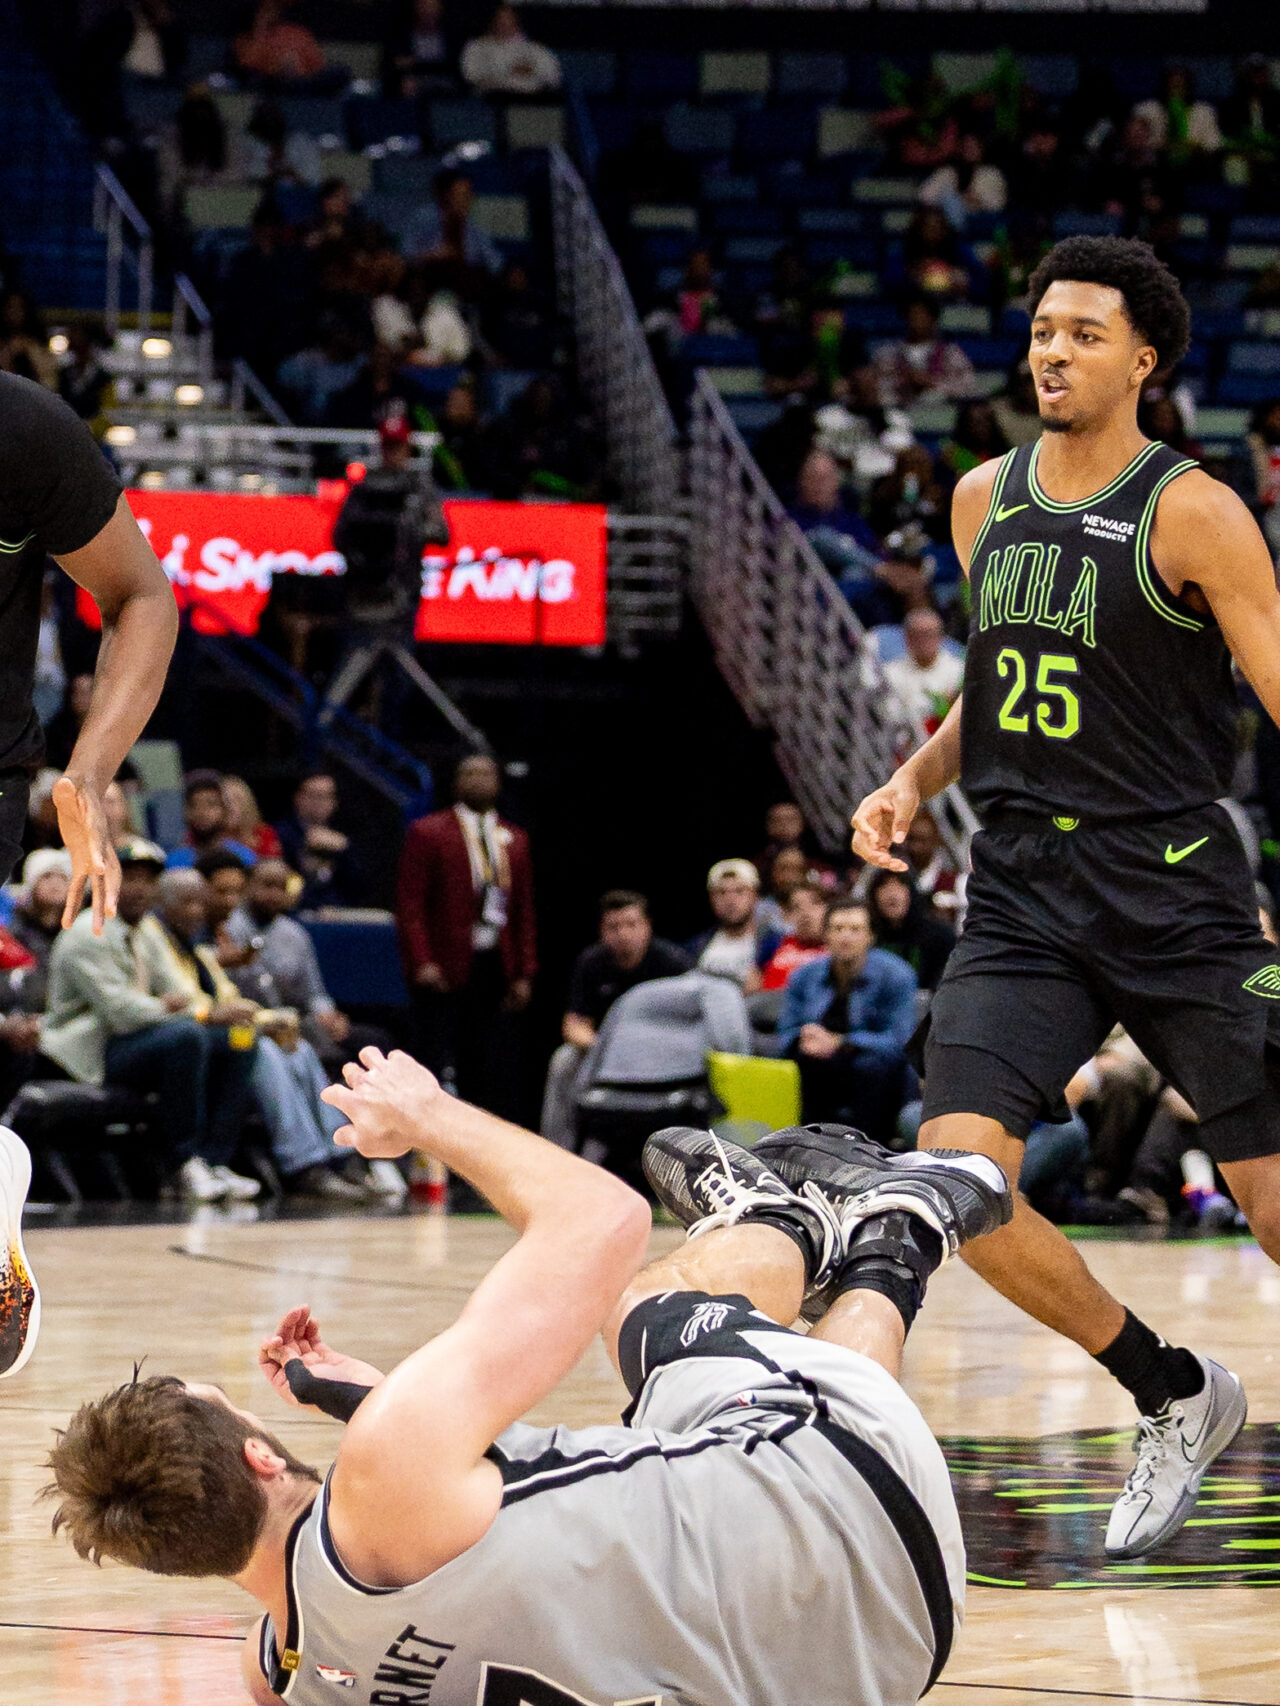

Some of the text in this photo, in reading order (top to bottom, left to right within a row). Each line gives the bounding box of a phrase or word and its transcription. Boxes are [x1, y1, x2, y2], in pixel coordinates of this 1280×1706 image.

[1081, 513, 1136, 535] NEWAGE
[1083, 526, 1127, 543] PRODUCTS
[979, 542, 1097, 649] NOLA
[996, 647, 1081, 740] 25
